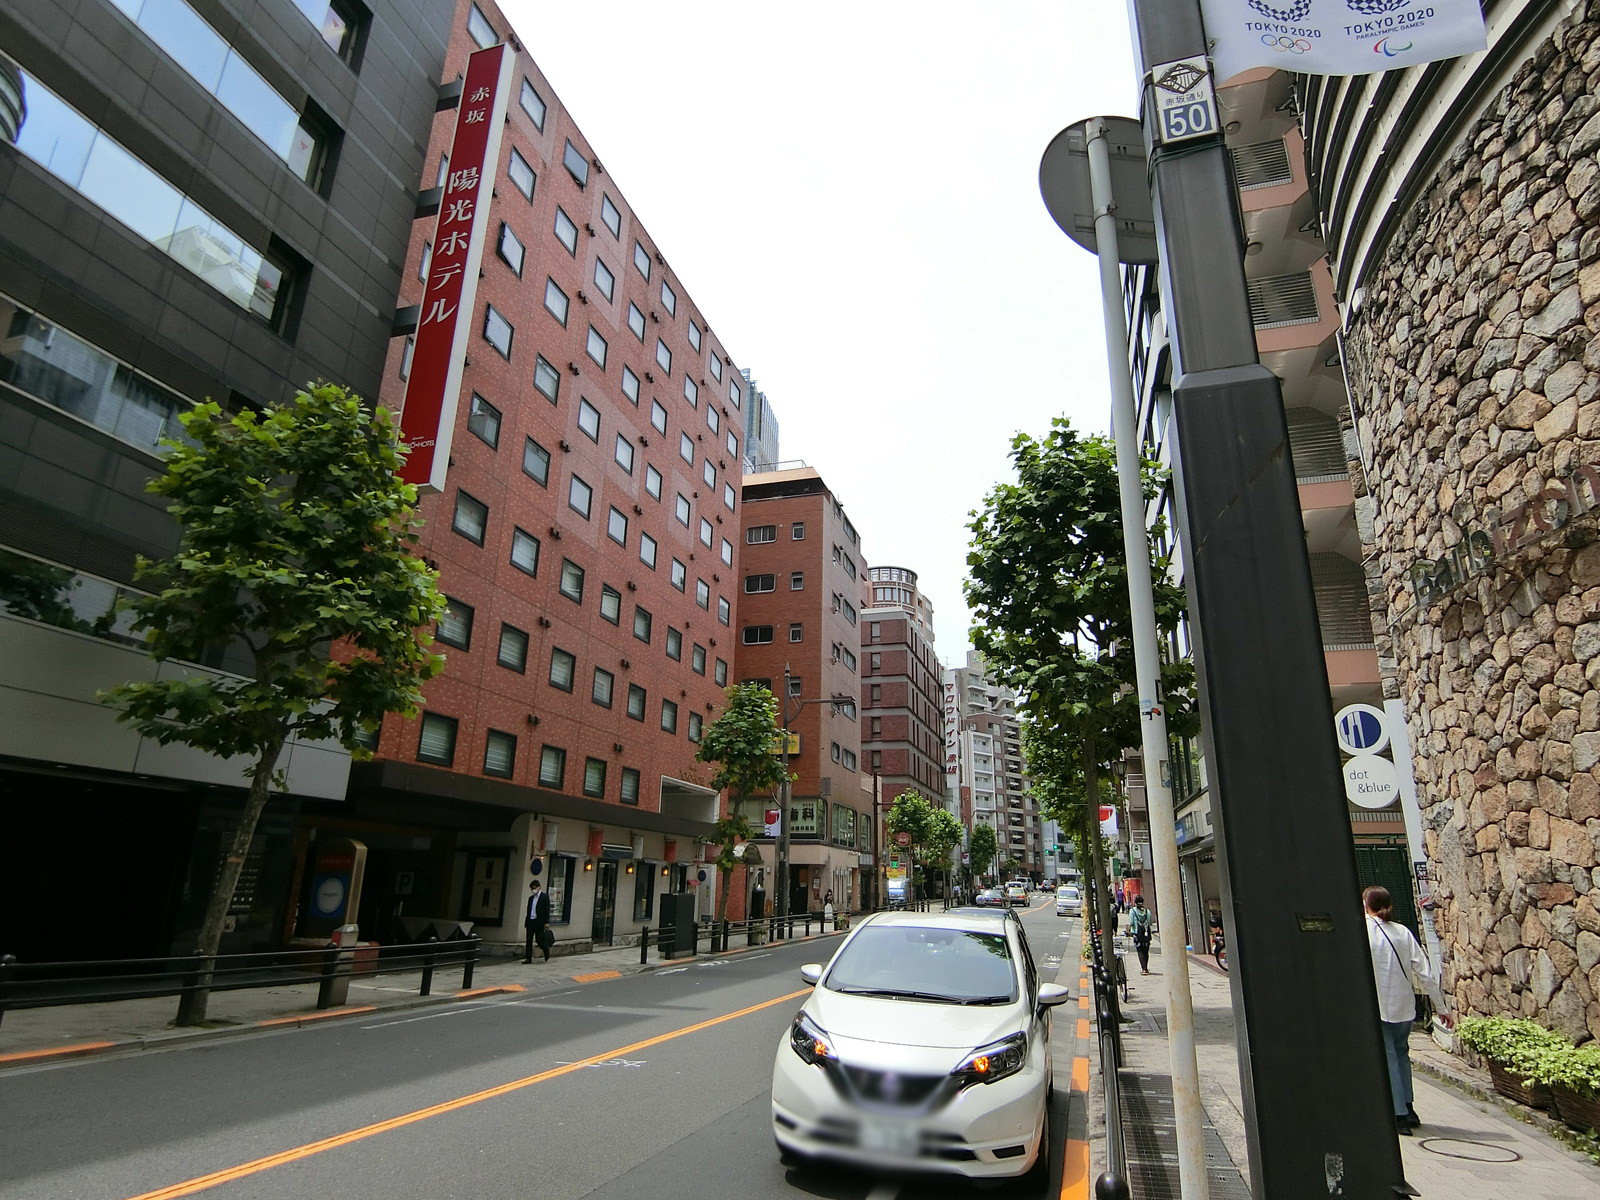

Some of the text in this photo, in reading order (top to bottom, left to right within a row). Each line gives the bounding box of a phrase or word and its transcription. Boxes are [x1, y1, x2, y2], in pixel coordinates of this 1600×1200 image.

[1245, 22, 1322, 38] TOKYO 2020
[1344, 7, 1435, 36] TOKYO 2020
[1356, 20, 1425, 40] PARALYMPIC GAMES
[465, 87, 490, 124] 赤坂
[1165, 91, 1204, 106] 赤坂通り
[1169, 103, 1207, 137] 50
[421, 166, 480, 326] 陽光ホテル
[1349, 769, 1369, 780] dot
[1357, 782, 1391, 794] &blue
